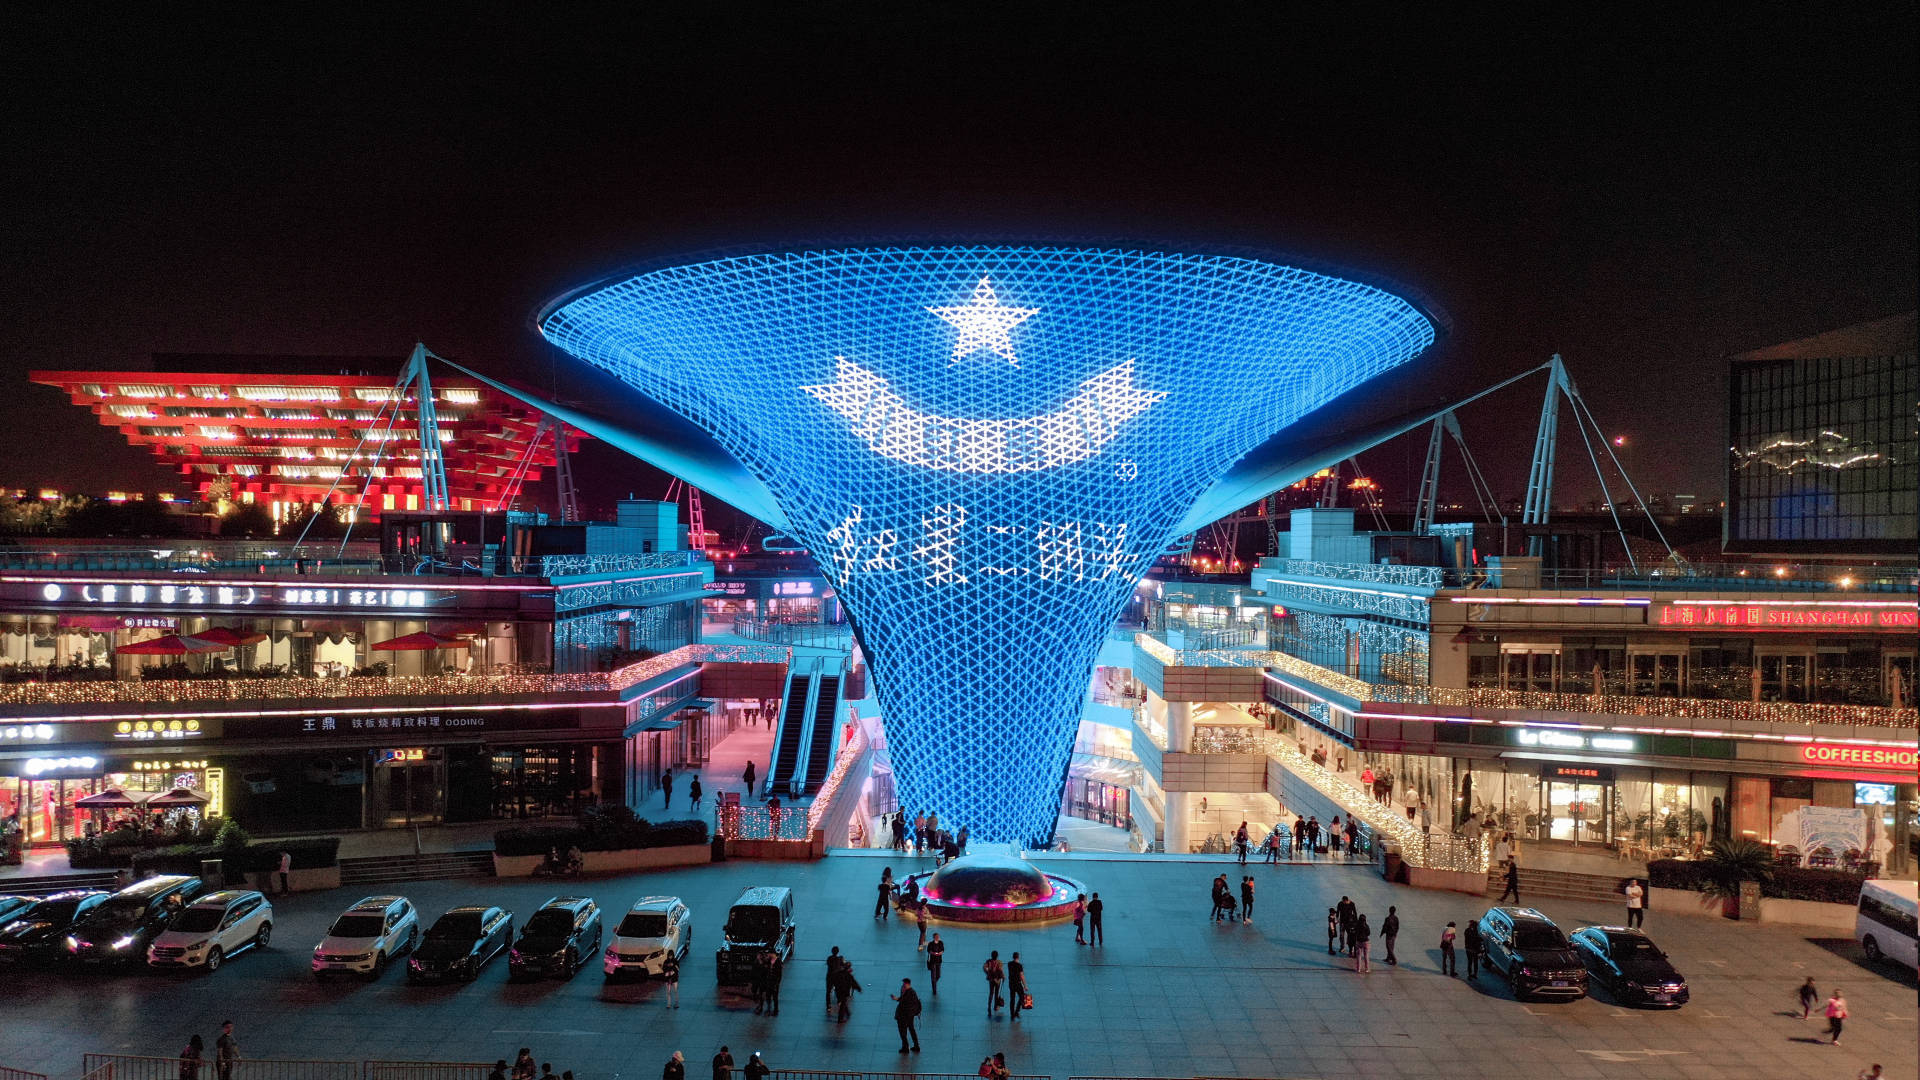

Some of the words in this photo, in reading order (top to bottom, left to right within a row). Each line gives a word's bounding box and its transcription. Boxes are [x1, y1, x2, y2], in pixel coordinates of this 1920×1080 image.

[1661, 607, 1760, 625] 上海小南国
[1768, 611, 1870, 625] SHANGHAI
[1880, 612, 1914, 625] MIN
[302, 716, 336, 731] 王鼎
